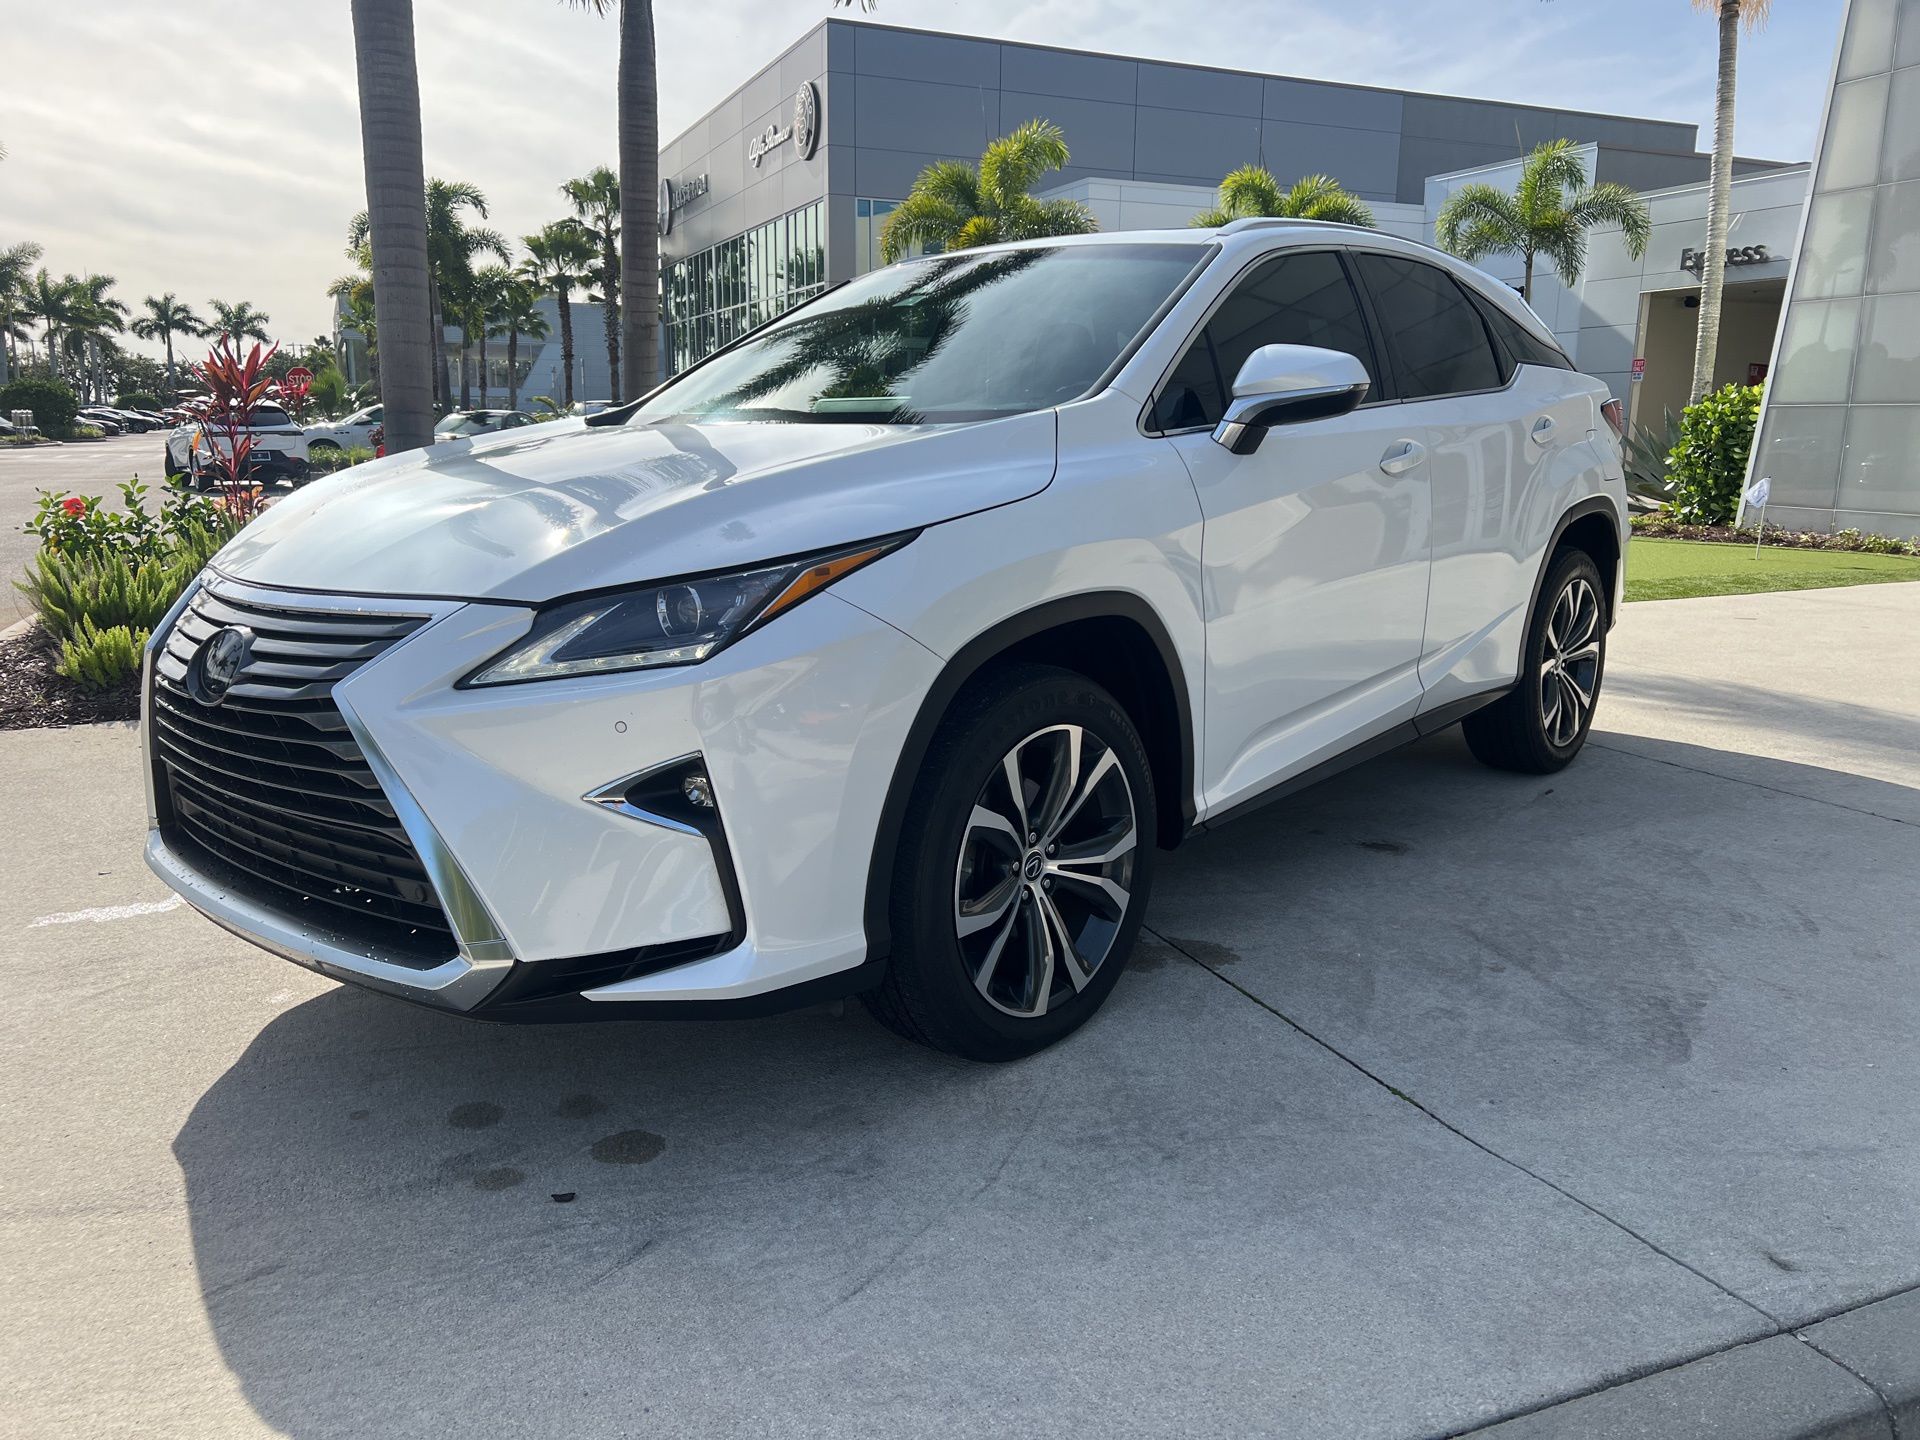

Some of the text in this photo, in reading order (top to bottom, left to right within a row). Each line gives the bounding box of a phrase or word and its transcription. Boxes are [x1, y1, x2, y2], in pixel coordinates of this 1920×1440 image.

[748, 125, 791, 168] Alfa Romeo
[1680, 244, 1768, 270] Exess
[288, 375, 312, 385] STOP
